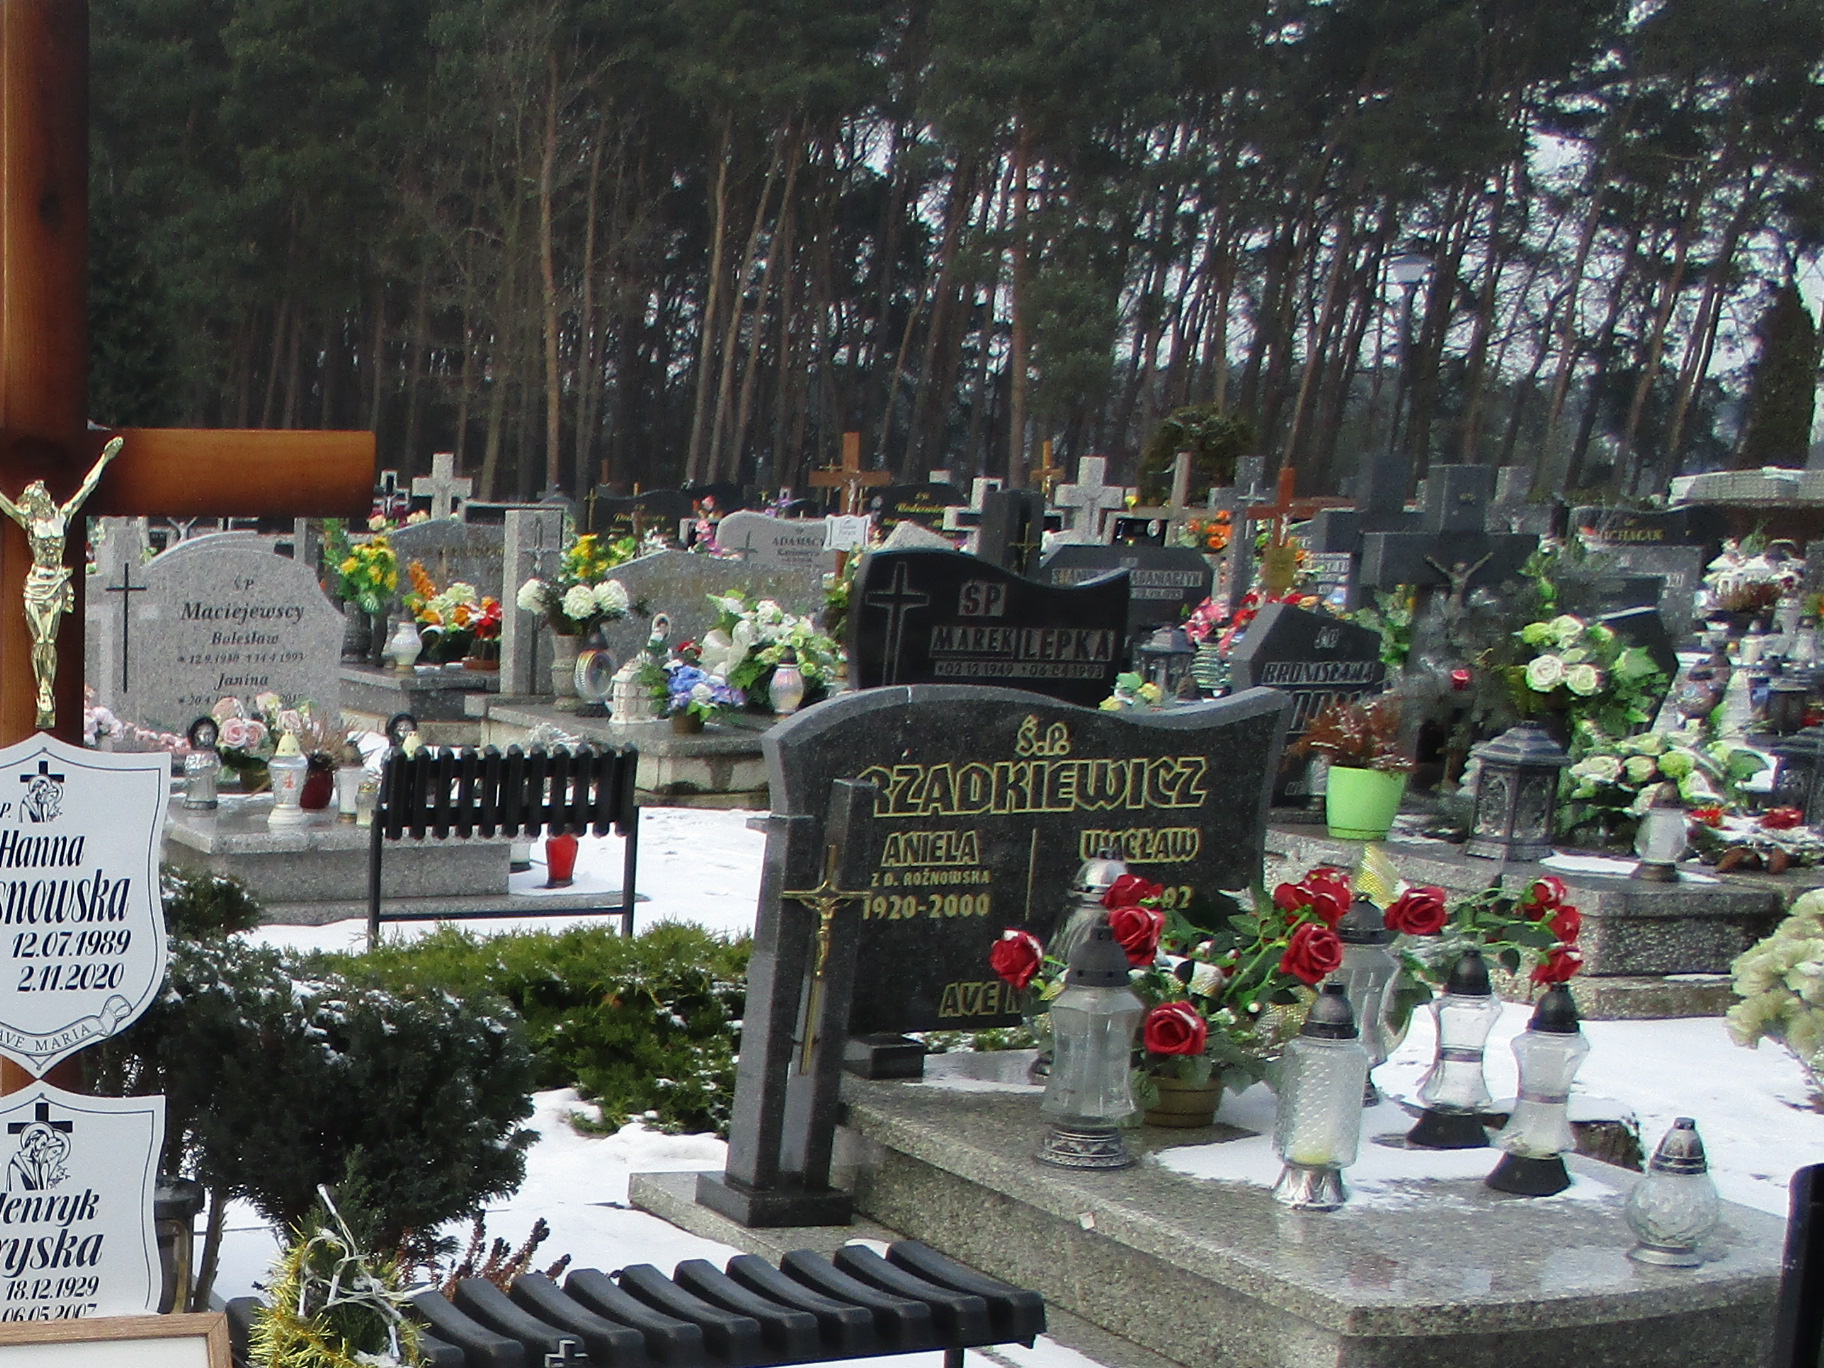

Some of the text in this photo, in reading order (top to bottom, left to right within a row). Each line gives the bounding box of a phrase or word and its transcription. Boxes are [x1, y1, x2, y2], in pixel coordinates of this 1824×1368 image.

[180, 602, 304, 625] Maciejewscy
[214, 673, 269, 690] Janina
[881, 829, 980, 868] ANIELA
[861, 892, 992, 920] 1920-2000
[12, 929, 132, 958] 12.07.1989
[17, 962, 125, 992] 2.11.2020
[34, 1024, 92, 1052] MARIA
[5, 1275, 100, 1302] 18.12.1929
